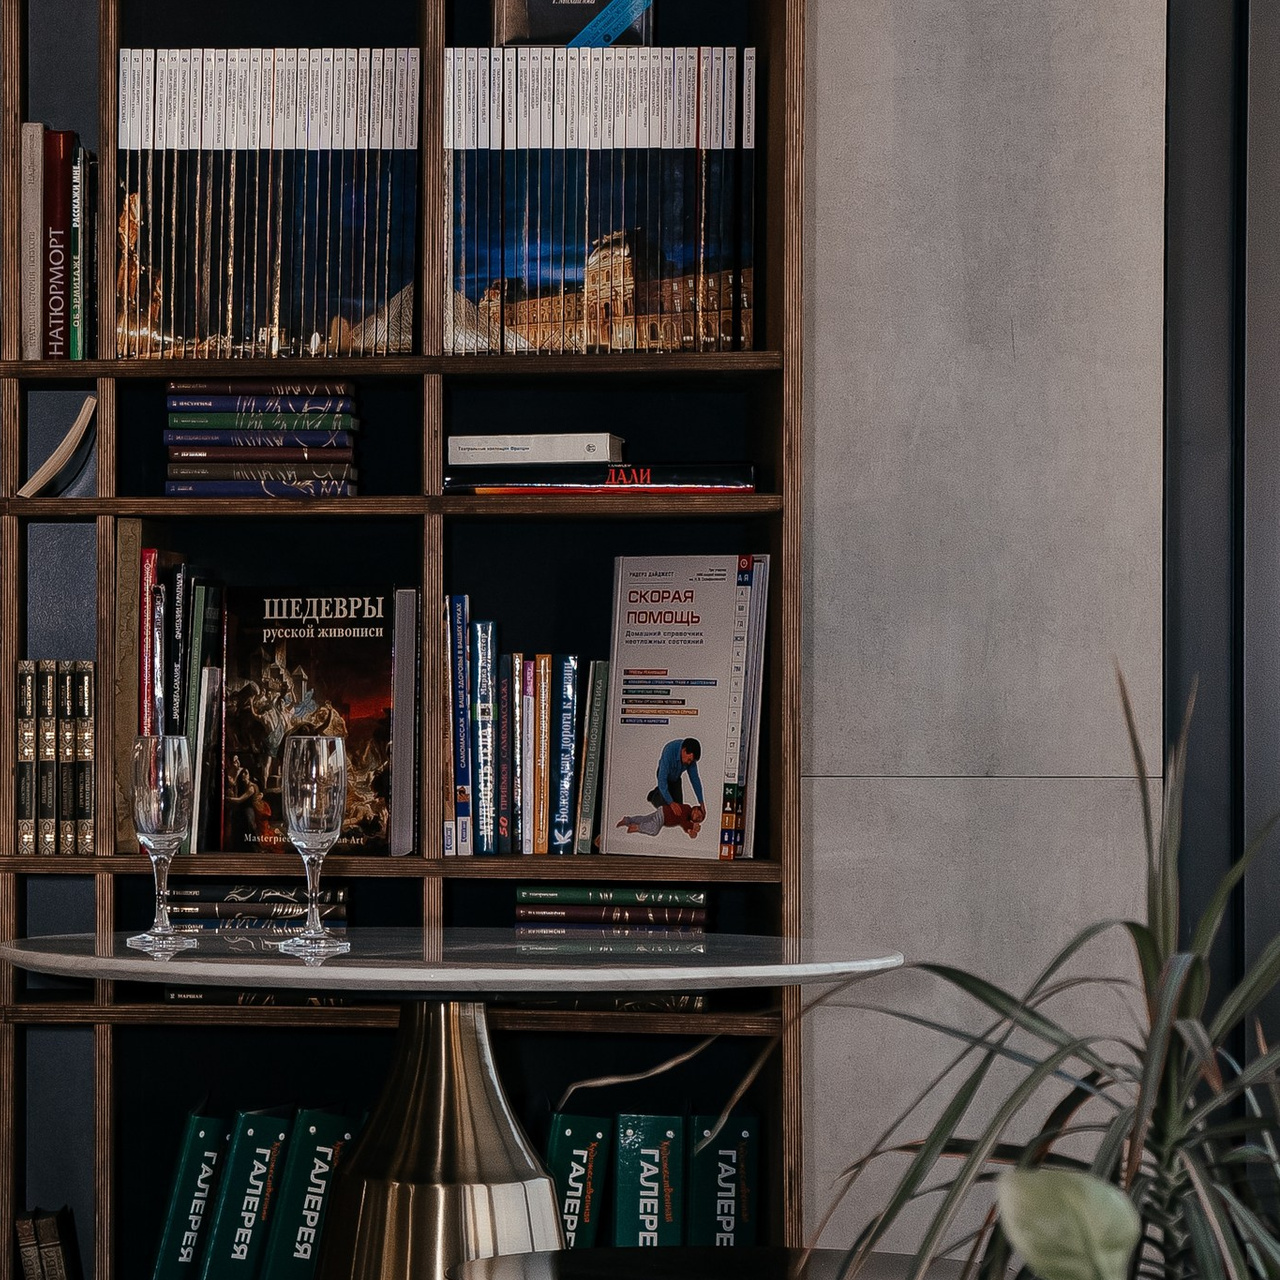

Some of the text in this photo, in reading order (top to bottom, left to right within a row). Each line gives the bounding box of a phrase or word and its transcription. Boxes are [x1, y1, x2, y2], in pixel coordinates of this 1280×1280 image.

[49, 227, 64, 355] НАТЮРМОРТ
[73, 313, 80, 327] ОБ
[605, 468, 652, 485] ДАЛИ
[263, 597, 384, 624] ШЕДЕВРЫ
[627, 611, 701, 626] ПОМОЩЬ
[628, 590, 694, 603] СКОРАЯ
[263, 625, 384, 643] русской живописи
[560, 713, 573, 750] дорога
[588, 679, 603, 751] БИОЭНЕРГЕТИКА
[499, 679, 508, 837] 50 САМОМАССАЖА
[559, 753, 570, 773] как
[583, 761, 595, 812] БИОСИНТЕЗ
[350, 835, 364, 844] Art
[177, 1151, 218, 1263] ГАЛЕРЕЯ
[231, 1148, 271, 1261] ГАЛЕРЕЯ
[293, 1147, 333, 1260] ГАЛЕРЕЯ
[563, 1149, 588, 1249] ГАЛЕРЕ
[639, 1149, 660, 1247] ГАЛЕРЕ
[716, 1149, 737, 1247] ГАЛЕРЕ
